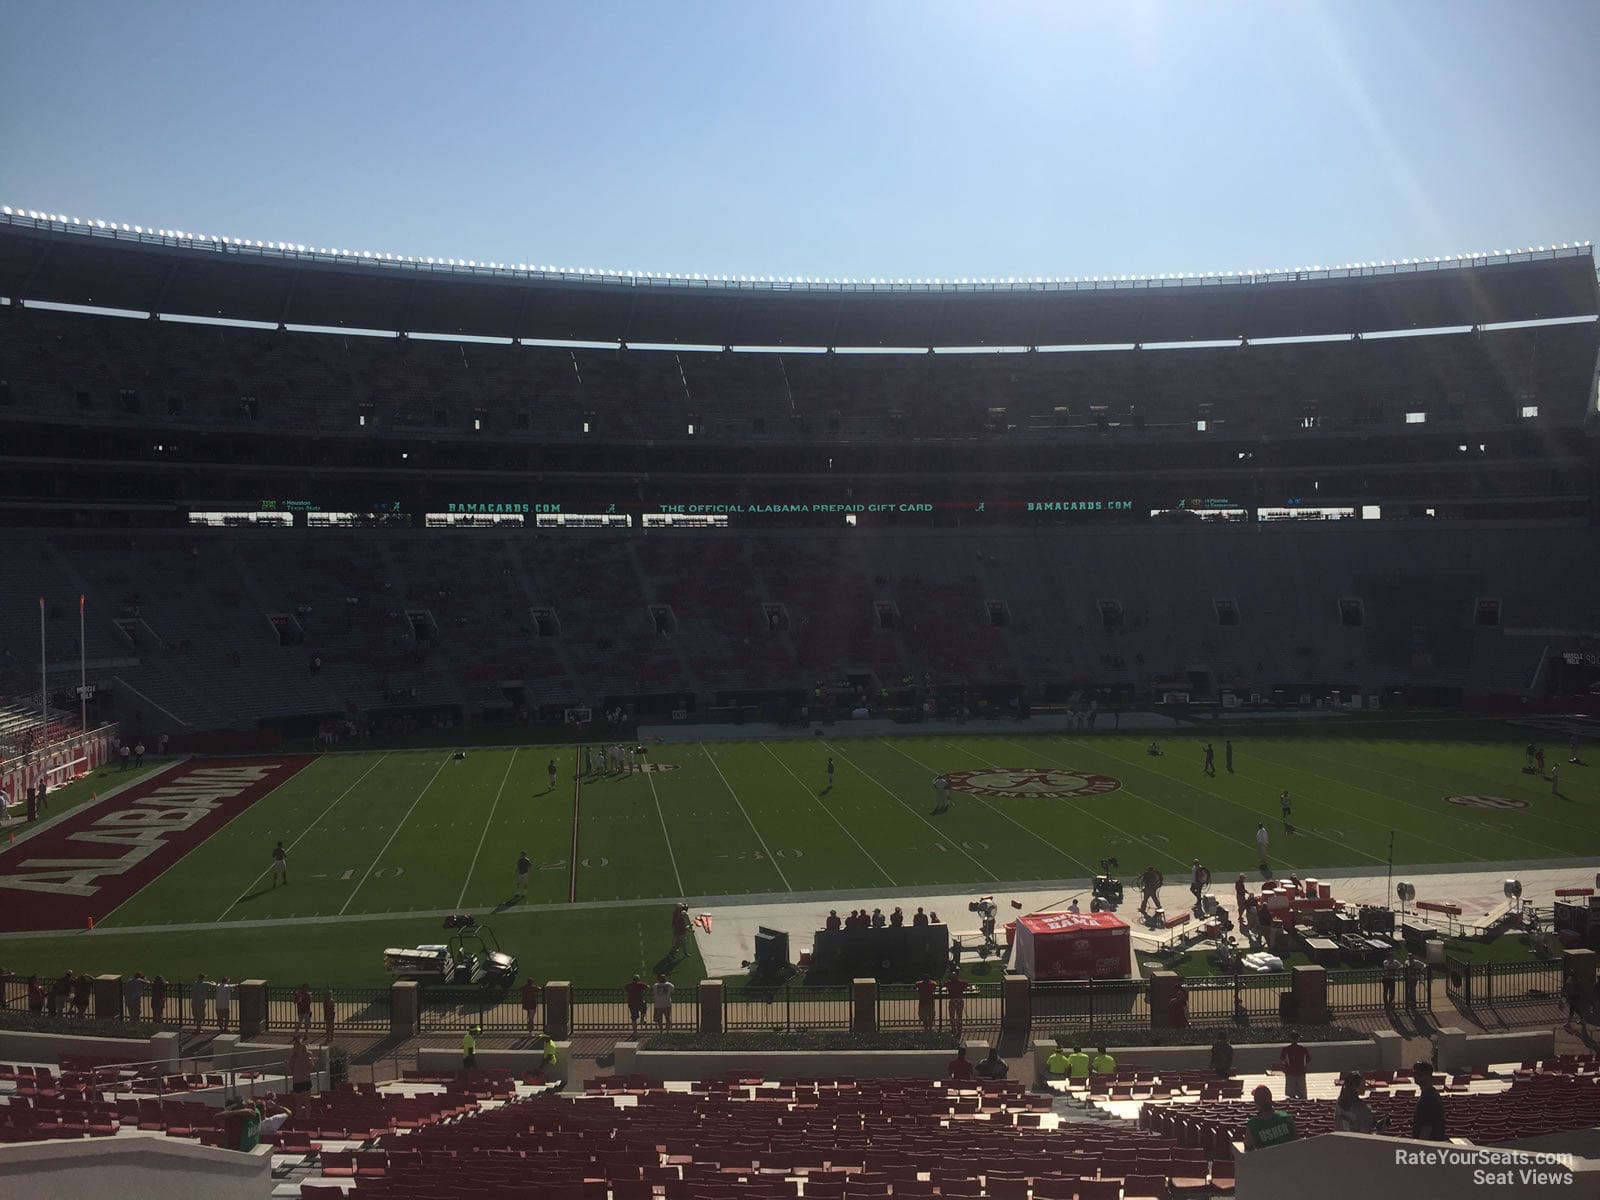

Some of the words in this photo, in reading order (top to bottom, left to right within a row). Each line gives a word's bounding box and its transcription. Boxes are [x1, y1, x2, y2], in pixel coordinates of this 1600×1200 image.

[449, 503, 561, 513] BAMACARDS.COM
[660, 504, 685, 512] THE
[688, 504, 745, 512] OFFICIAL
[748, 504, 809, 512] ALABAMA
[812, 504, 865, 512] PREPAID
[868, 504, 896, 512] GIFT
[899, 503, 933, 512] CARD
[1027, 501, 1132, 511] BAMACARDS.COM
[0, 764, 283, 896] ALABAMA
